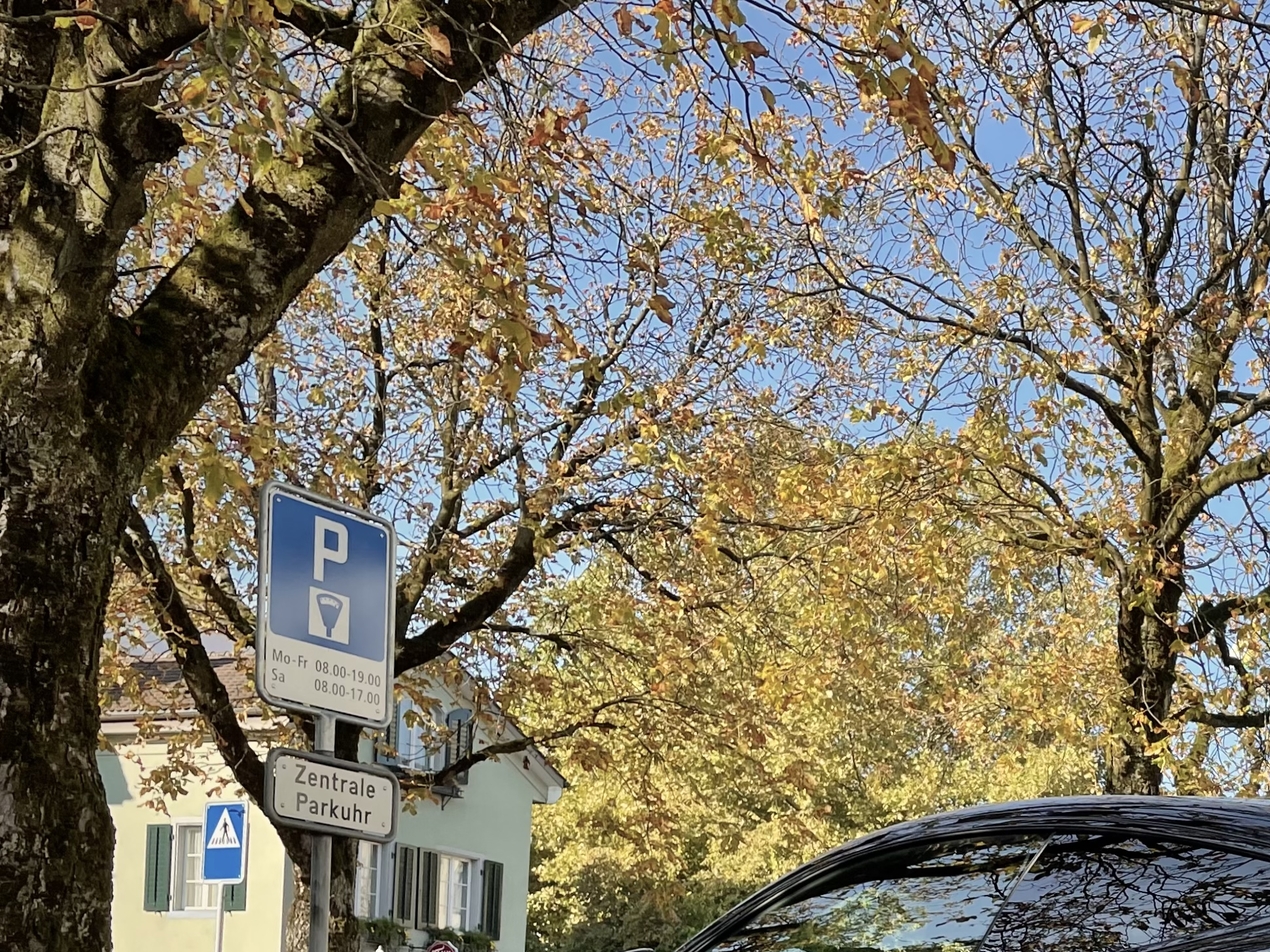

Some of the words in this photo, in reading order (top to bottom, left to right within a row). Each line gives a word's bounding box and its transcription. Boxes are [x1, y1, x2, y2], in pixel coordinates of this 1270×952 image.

[313, 515, 349, 583] P
[271, 668, 285, 683] Sa
[314, 678, 380, 706] 08.00-17.00
[315, 660, 381, 687] 08.00-19.00
[295, 763, 376, 799] Zentrale
[296, 792, 372, 825] Parkuhr
